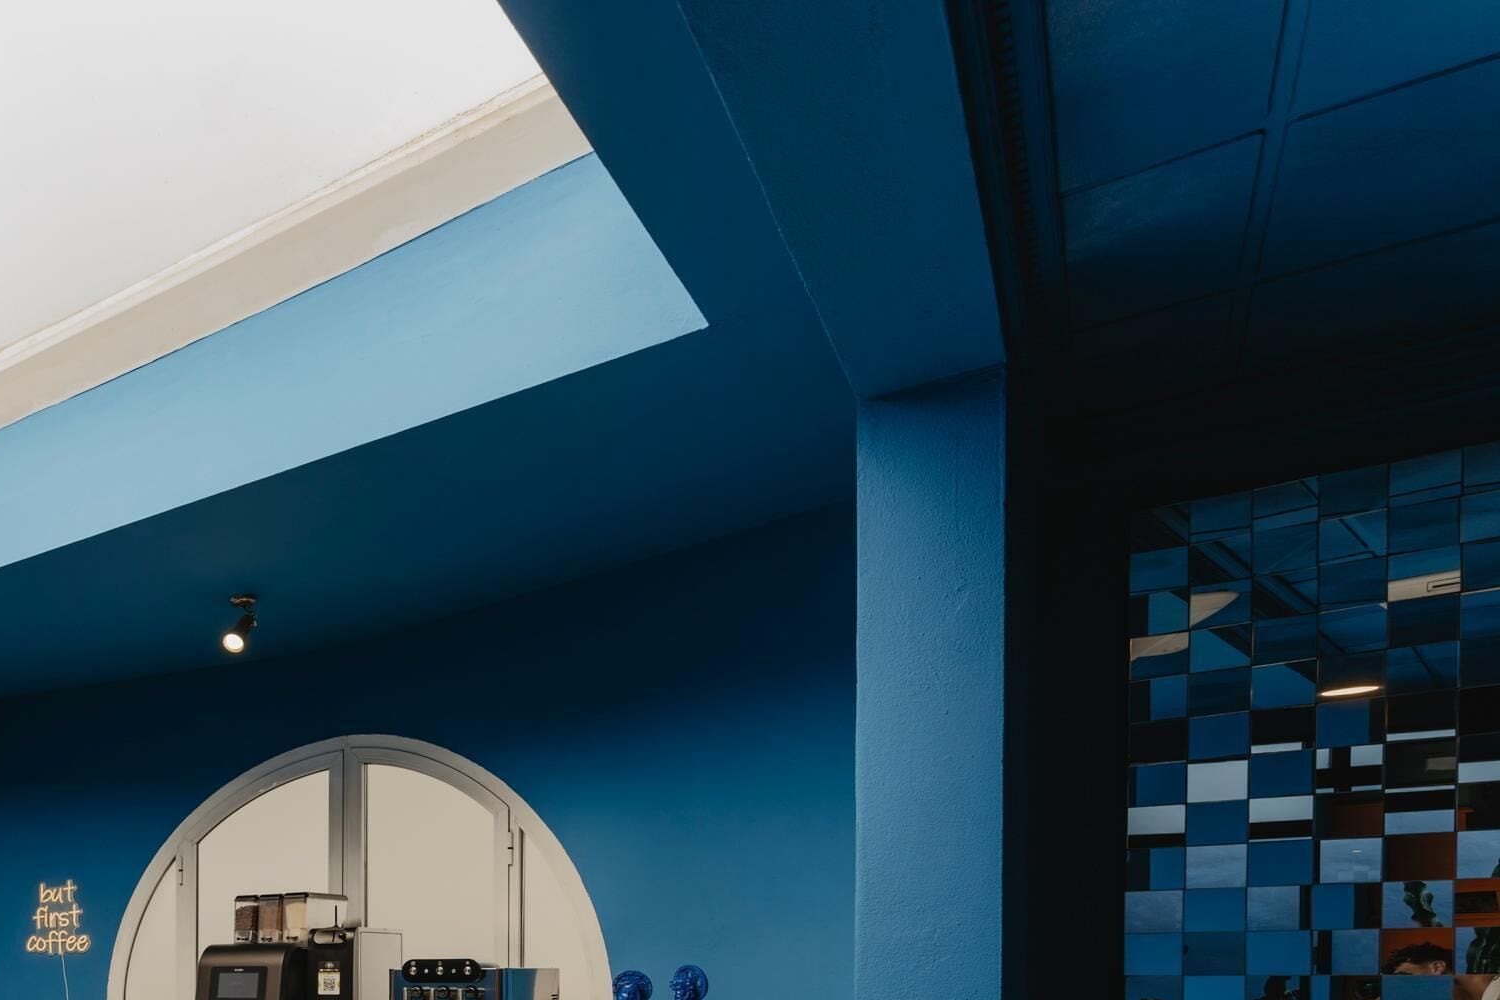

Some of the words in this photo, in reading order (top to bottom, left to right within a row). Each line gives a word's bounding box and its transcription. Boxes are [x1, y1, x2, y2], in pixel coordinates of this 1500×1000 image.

[39, 880, 77, 903] but
[32, 904, 83, 929] first
[26, 930, 90, 955] coffee
